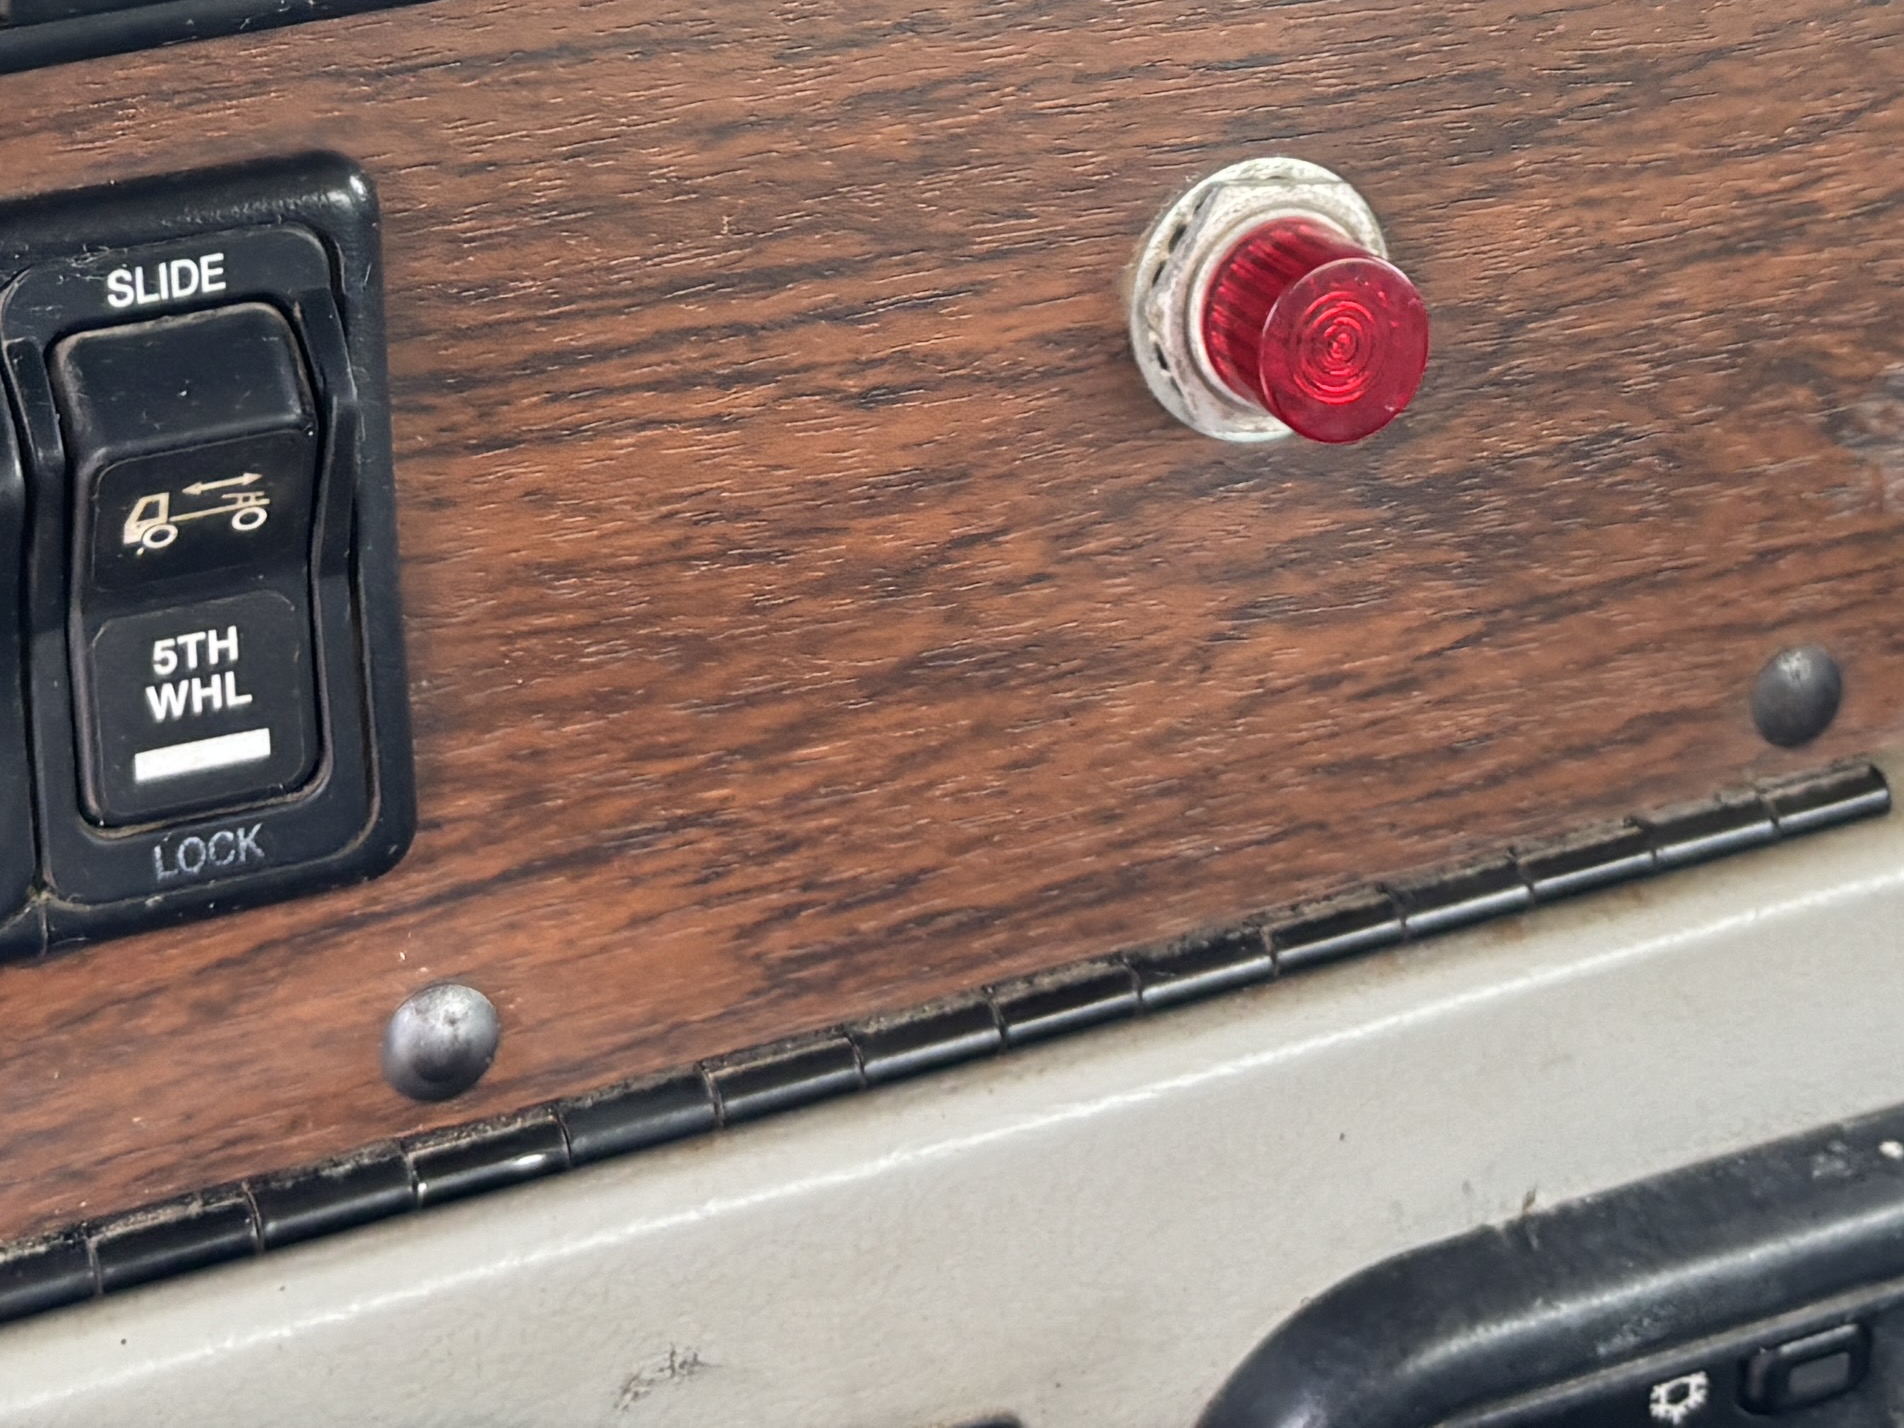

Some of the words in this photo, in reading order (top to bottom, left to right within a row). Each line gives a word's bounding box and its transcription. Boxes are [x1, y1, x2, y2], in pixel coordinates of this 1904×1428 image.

[105, 253, 227, 309] SLIDE
[151, 627, 239, 677] 5TH
[144, 669, 253, 723] WHL
[151, 825, 264, 879] LOCK
